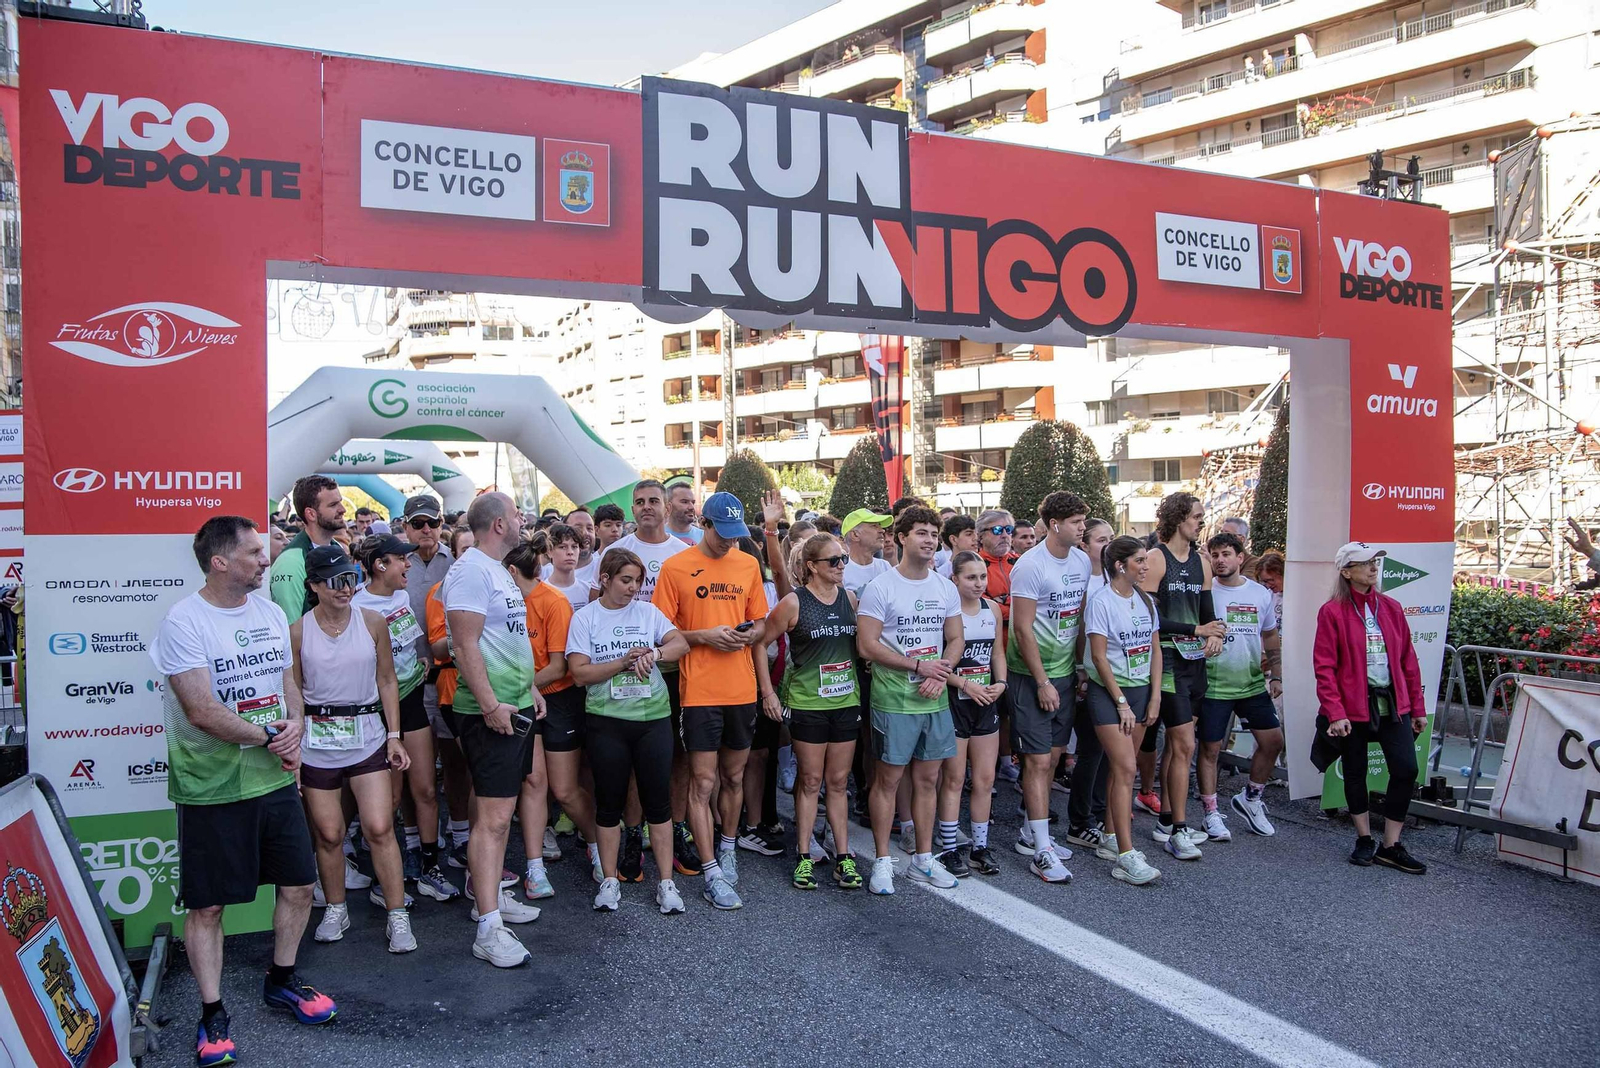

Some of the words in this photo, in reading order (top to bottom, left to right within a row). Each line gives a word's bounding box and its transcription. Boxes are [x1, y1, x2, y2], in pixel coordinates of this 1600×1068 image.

[49, 88, 230, 156] VIGO
[374, 140, 522, 173] CONCELLO
[658, 92, 900, 209] RUN
[64, 144, 300, 199] DEPORTE
[393, 169, 429, 192] DE
[439, 173, 505, 198] VIGO
[1164, 228, 1251, 252] CONCELLO
[1176, 251, 1197, 267] DE
[1203, 254, 1242, 272] VIGO
[1333, 236, 1412, 282] VIGO
[1340, 273, 1444, 311] DEPORTE
[57, 323, 119, 341] Frutas
[181, 328, 238, 346] Nieves
[416, 384, 476, 393] asociación
[417, 395, 468, 406] española
[1366, 393, 1438, 418] amura
[416, 407, 453, 417] contra
[456, 408, 465, 417] el
[467, 408, 505, 418] cáncer
[114, 471, 242, 490] HYUNDAI
[1388, 485, 1445, 500] HYUNDAI
[136, 497, 193, 508] Hyupersa
[195, 497, 222, 508] Vigo
[1397, 502, 1423, 511] Hyupersa
[1423, 502, 1436, 511] Vigo
[46, 580, 111, 589] OMODA
[121, 578, 184, 588] JAECOO
[73, 593, 159, 604] resnovamotor
[1050, 592, 1062, 601] En
[1047, 610, 1059, 620] Vi
[1404, 605, 1445, 614] ASERGALICIA
[897, 616, 910, 625] En
[506, 621, 526, 635] Vig
[91, 632, 139, 643] Smurfit
[896, 635, 922, 647] Vigo
[1222, 635, 1235, 645] go
[1420, 631, 1438, 643] auga
[91, 642, 147, 653] Westrock
[392, 645, 403, 657] go
[595, 644, 608, 654] En
[962, 642, 993, 659] eliki
[596, 653, 616, 662] contra
[214, 658, 235, 673] En
[244, 670, 253, 679] el
[830, 673, 849, 683] 1905
[65, 681, 134, 697] GranVía
[217, 686, 257, 704] Vigo
[97, 697, 116, 705] Vigo
[251, 711, 277, 725] 2550
[1368, 767, 1382, 776] Vigo
